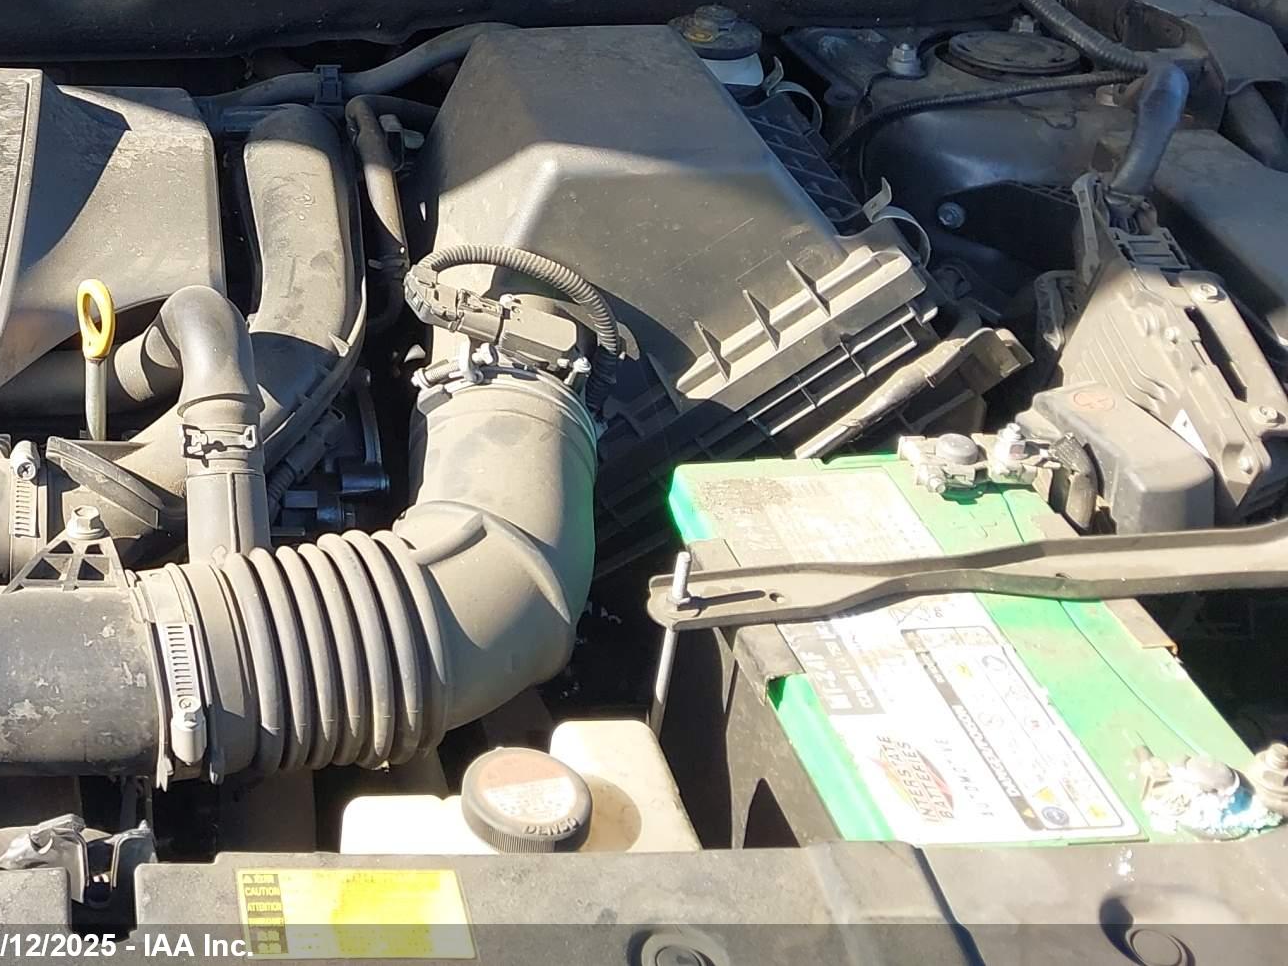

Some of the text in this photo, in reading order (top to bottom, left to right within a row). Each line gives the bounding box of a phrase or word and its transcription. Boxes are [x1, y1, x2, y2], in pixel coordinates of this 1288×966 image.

[877, 736, 940, 822] INTERSTATE
[897, 741, 954, 819] BATTERIES
[523, 817, 581, 836] DENSO
[245, 886, 281, 896] CAUTION
